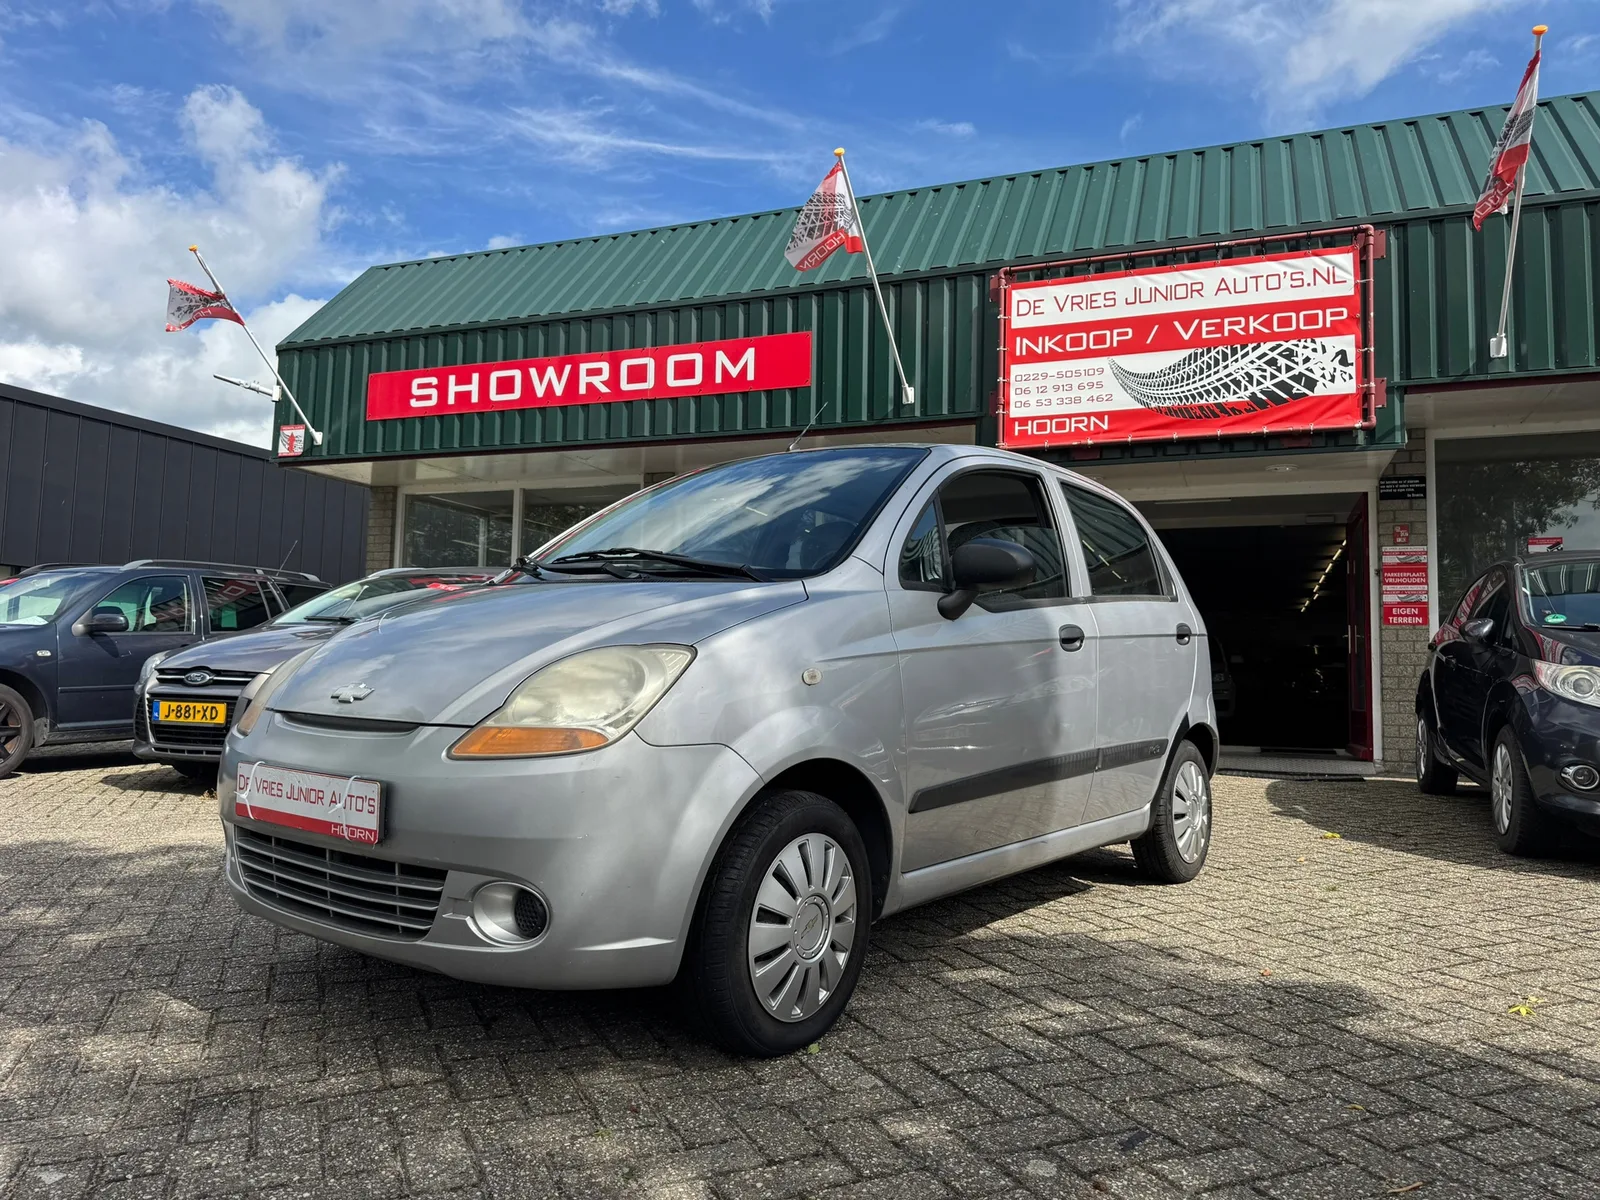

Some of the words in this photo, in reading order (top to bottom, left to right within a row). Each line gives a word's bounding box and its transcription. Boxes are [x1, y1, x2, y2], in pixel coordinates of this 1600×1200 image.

[1015, 296, 1045, 318] DE
[1054, 291, 1117, 312] VRIES
[1125, 282, 1205, 306] JUNIOR
[1214, 265, 1347, 298] AUTO'S.NL
[1015, 327, 1133, 356] INKOOP
[1146, 324, 1159, 344] /
[1173, 307, 1348, 340] VERKOOP
[409, 347, 756, 409] SHOWROOM
[1014, 367, 1105, 383] 0229-505109
[1014, 387, 1030, 396] 06
[1036, 385, 1048, 395] 12
[1052, 384, 1074, 394] 913
[1078, 382, 1104, 393] 695
[1014, 400, 1031, 409] 06
[1035, 398, 1053, 408] 53
[1058, 396, 1082, 407] 338
[1087, 393, 1113, 404] 462
[1014, 415, 1109, 436] HOORN
[1388, 616, 1423, 624] TERREIN
[1392, 607, 1419, 615] EIGEN
[164, 704, 218, 721] J-881-XD
[254, 778, 283, 798] VRIES
[286, 783, 325, 806] JUNIOR
[331, 823, 375, 842] HOORN
